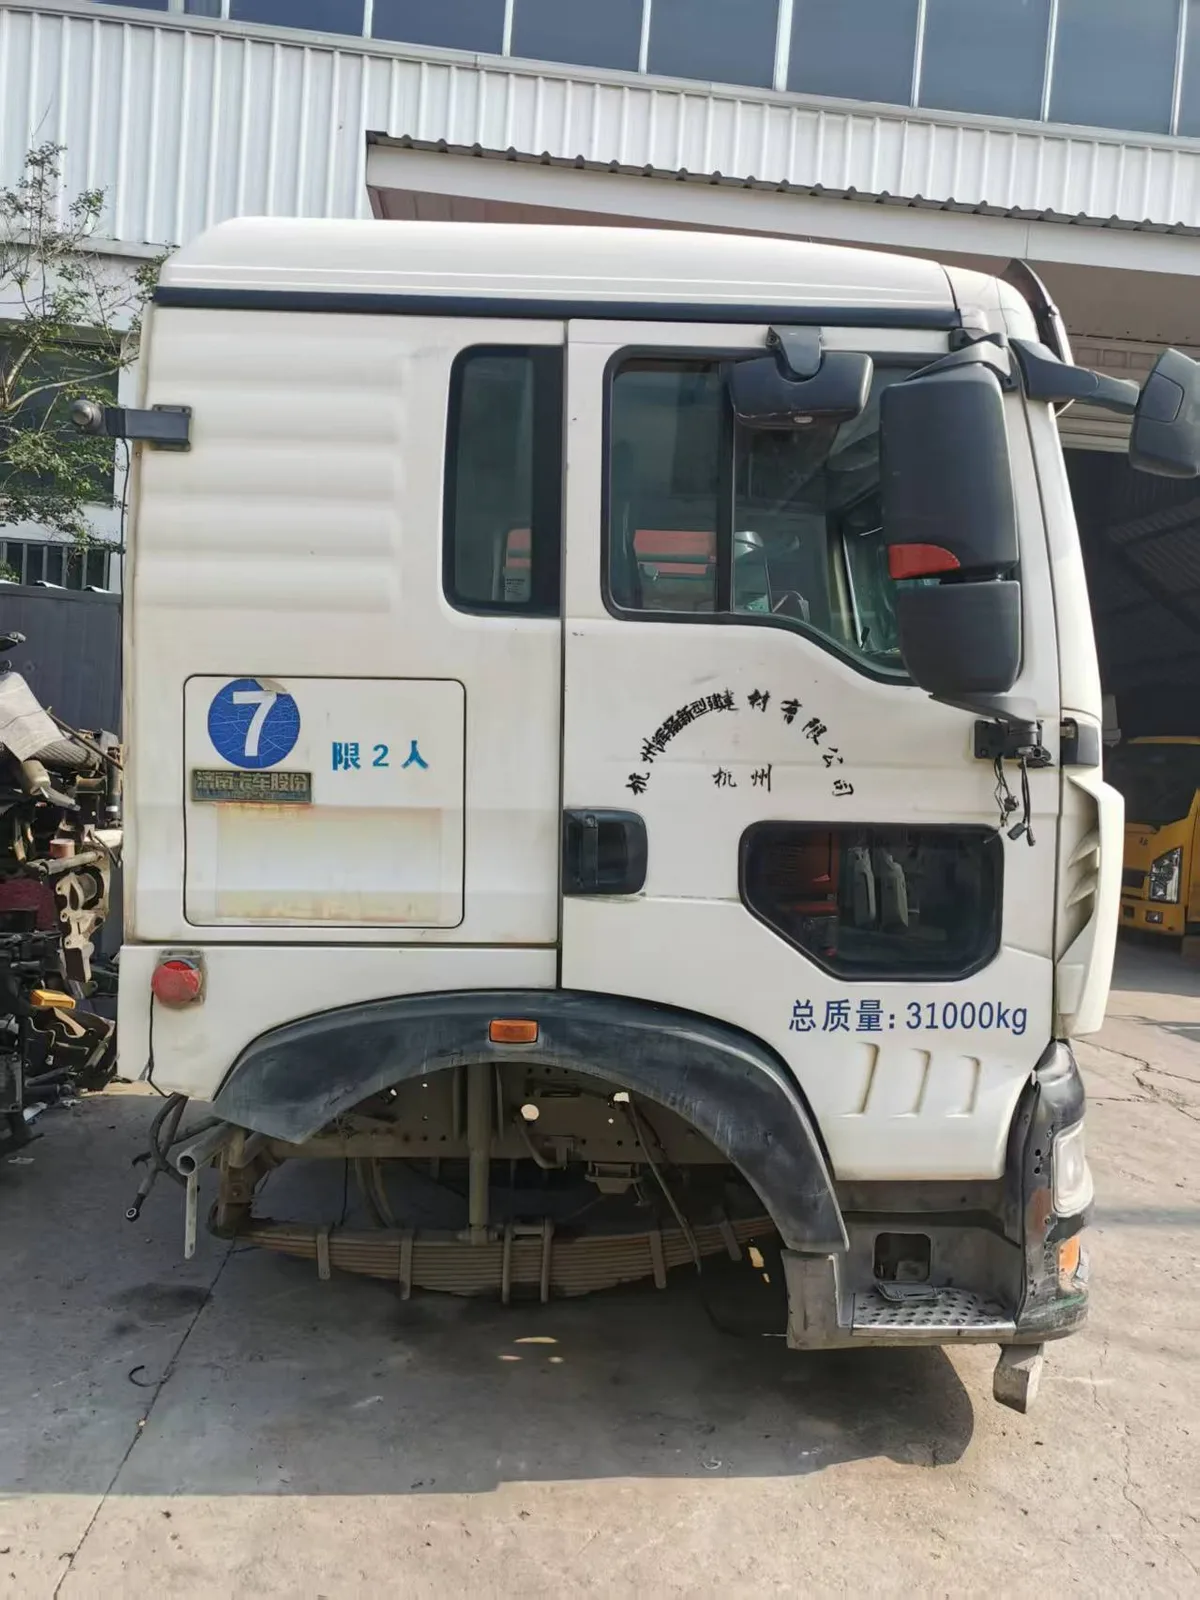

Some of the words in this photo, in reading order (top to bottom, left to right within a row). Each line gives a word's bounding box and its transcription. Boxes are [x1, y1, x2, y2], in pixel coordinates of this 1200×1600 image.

[232, 690, 278, 758] 7
[332, 740, 428, 771] 限2人
[712, 763, 773, 793] 杭州
